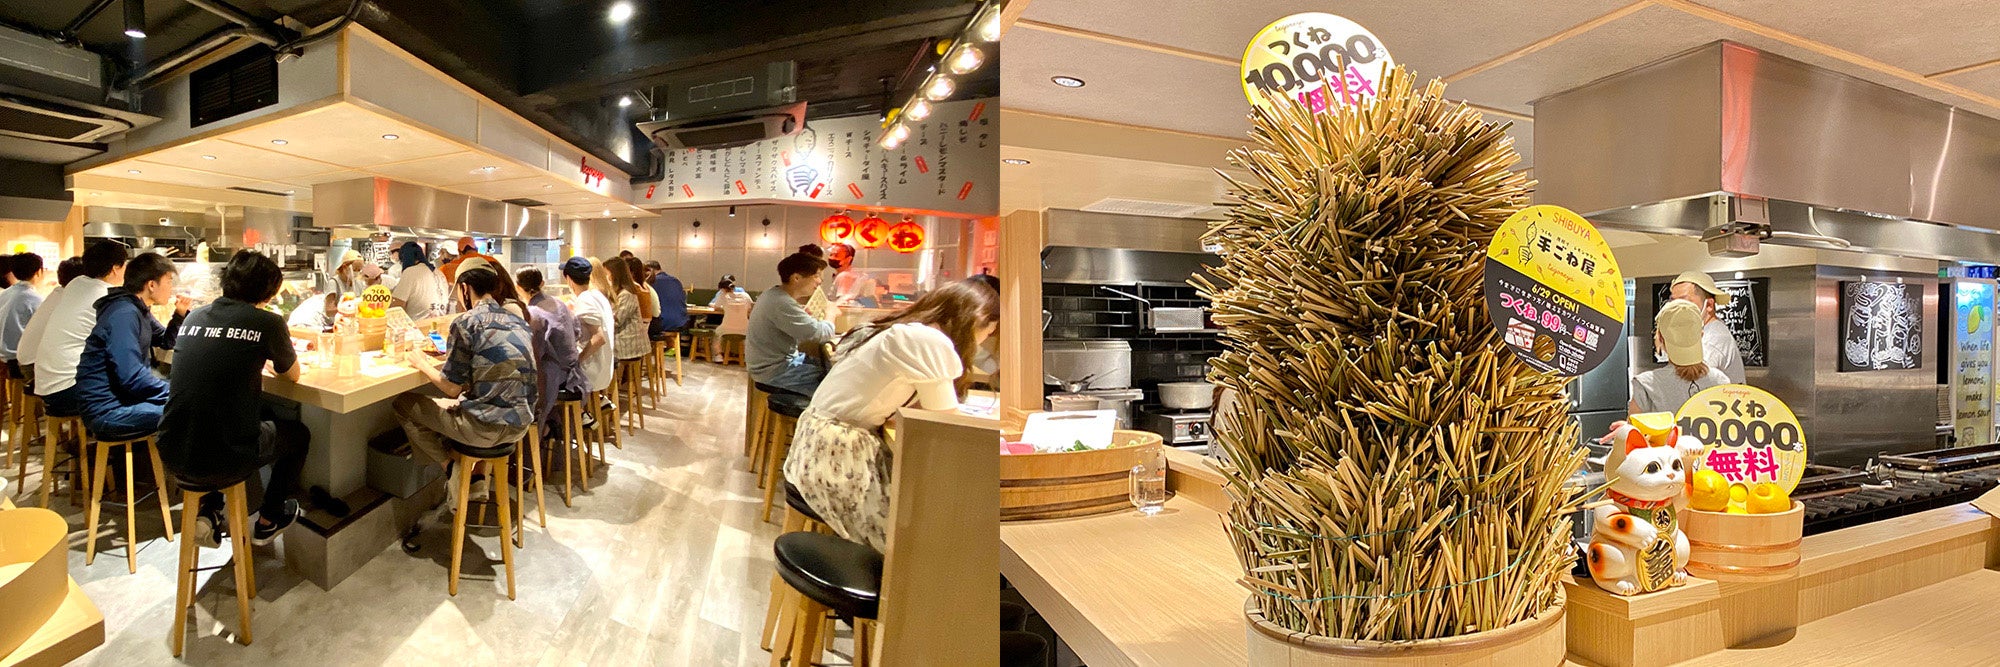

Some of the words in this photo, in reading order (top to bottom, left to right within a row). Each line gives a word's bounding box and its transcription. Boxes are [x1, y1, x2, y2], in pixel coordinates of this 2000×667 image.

[1268, 26, 1331, 56] つくね
[829, 222, 922, 249] つくね
[1553, 212, 1591, 241] SHIBUYA
[1537, 235, 1596, 278] 手ごね屋
[1531, 284, 1551, 299] 6/29
[1552, 294, 1579, 314] OPEN!
[187, 325, 202, 337] AT
[204, 327, 223, 338] THE
[226, 327, 262, 343] BEACH
[1960, 341, 1979, 351] When
[1960, 357, 1976, 372] gives
[1977, 360, 1989, 371] you
[1965, 390, 1982, 401] make
[1708, 399, 1767, 418] つくね
[1956, 409, 1976, 420] lemon
[1705, 446, 1780, 483] 無料
